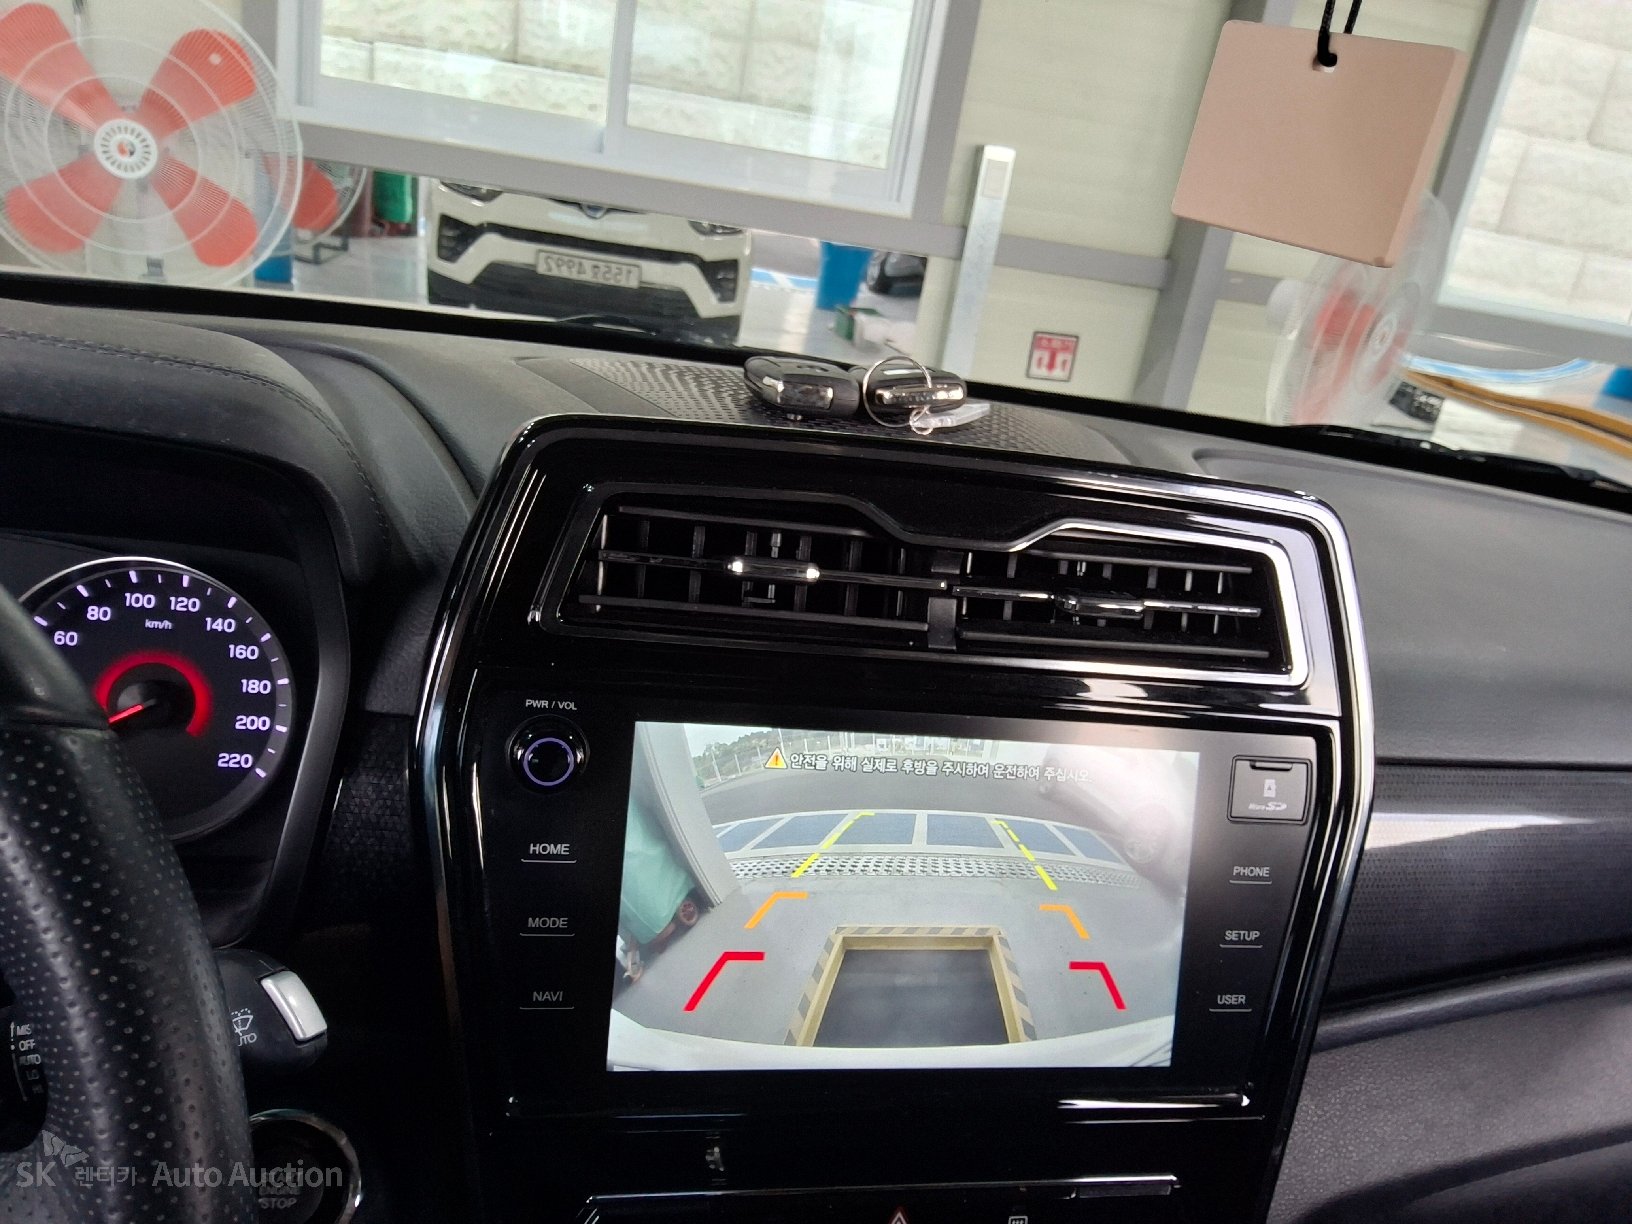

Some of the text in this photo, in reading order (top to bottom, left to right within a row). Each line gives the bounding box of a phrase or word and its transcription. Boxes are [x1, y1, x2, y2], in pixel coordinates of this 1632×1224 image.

[124, 593, 156, 609] 100
[170, 597, 200, 612] 120
[86, 606, 111, 622] 80
[145, 619, 173, 630] km/h
[205, 617, 236, 633] 140
[53, 631, 78, 647] 60
[228, 644, 259, 660] 160
[240, 679, 271, 695] 180
[525, 699, 549, 709] PWR
[557, 701, 578, 711] VOL
[235, 716, 271, 731] 200
[217, 753, 253, 769] 220
[790, 753, 828, 771] 안전을
[832, 755, 857, 772] 위해
[861, 756, 898, 774] 실제로
[901, 758, 938, 776] 후방을
[941, 760, 989, 778] 주시하여
[993, 761, 1039, 780] 운전하여
[529, 843, 570, 855] HOME
[1233, 866, 1270, 877] PHONE
[528, 917, 568, 928] MODE
[1225, 930, 1260, 941] SETUP
[533, 991, 563, 1002] NAVI
[1217, 994, 1246, 1005] USER
[19, 1039, 36, 1052] OFF
